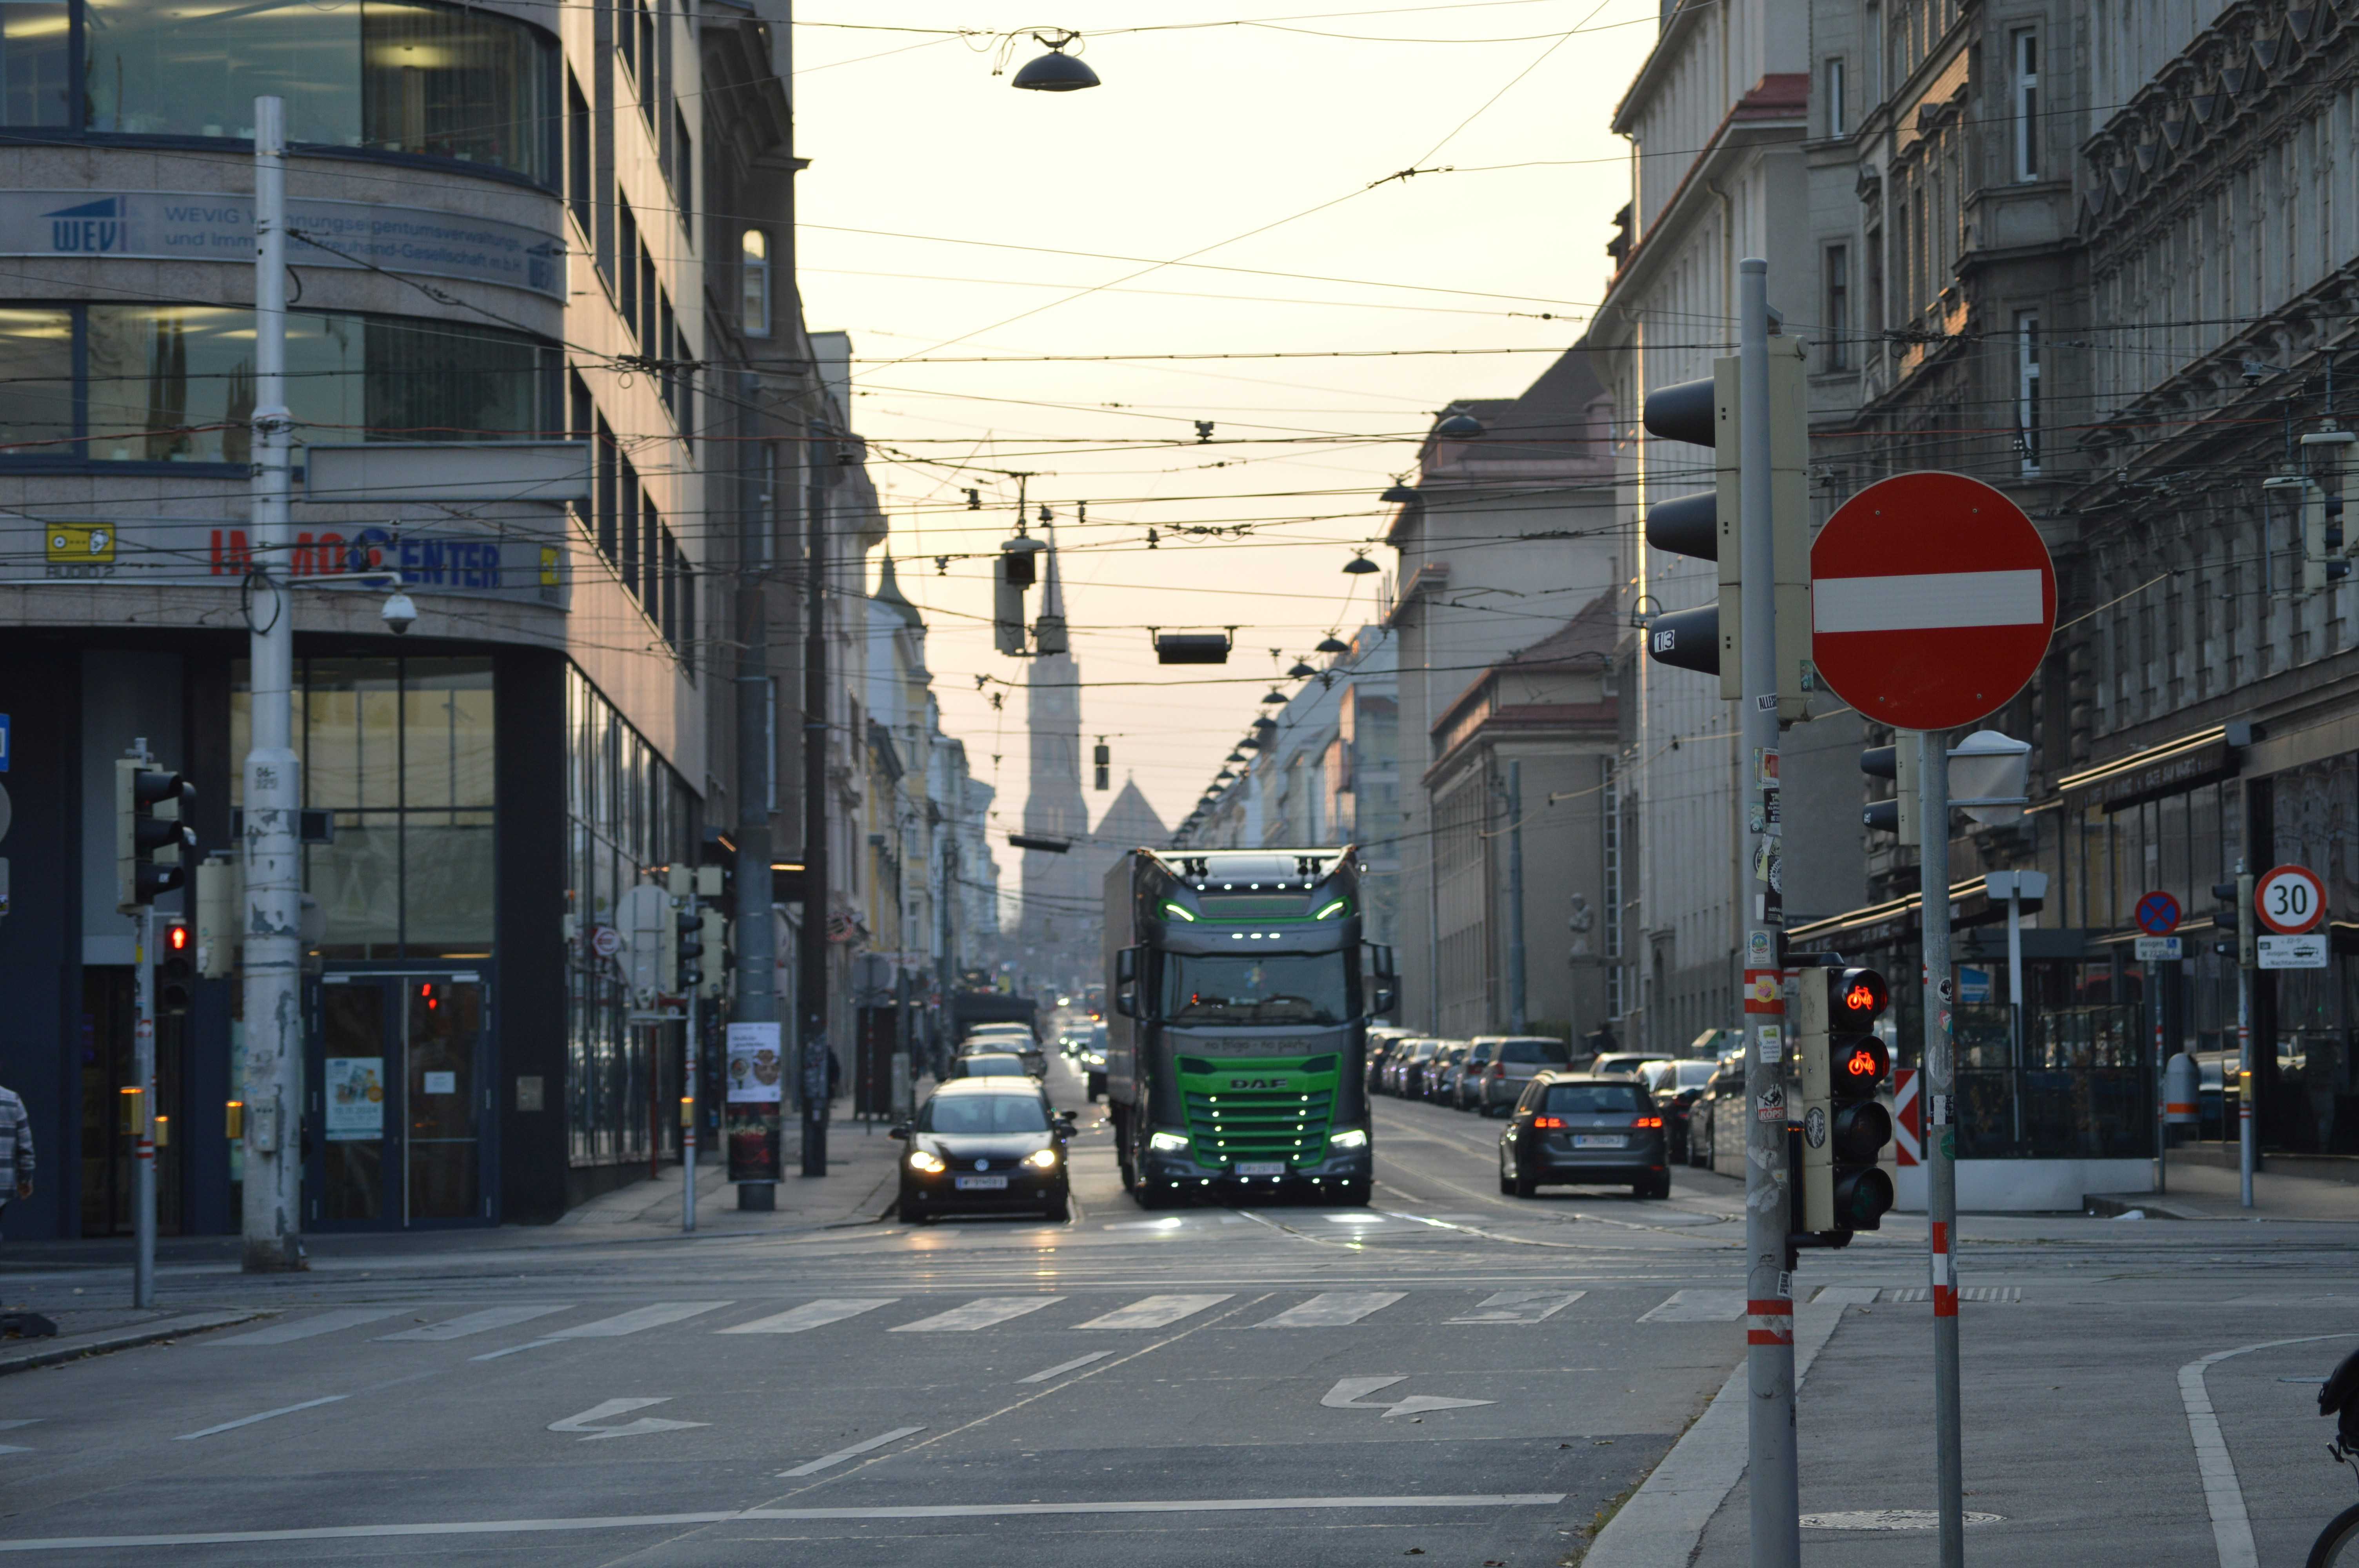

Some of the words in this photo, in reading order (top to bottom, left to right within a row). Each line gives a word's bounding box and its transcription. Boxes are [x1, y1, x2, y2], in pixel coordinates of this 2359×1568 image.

[164, 206, 240, 223] WEVIG
[165, 232, 205, 245] und
[1657, 631, 1674, 651] 13
[2273, 884, 2307, 915] 30
[1230, 1079, 1288, 1090] DAF
